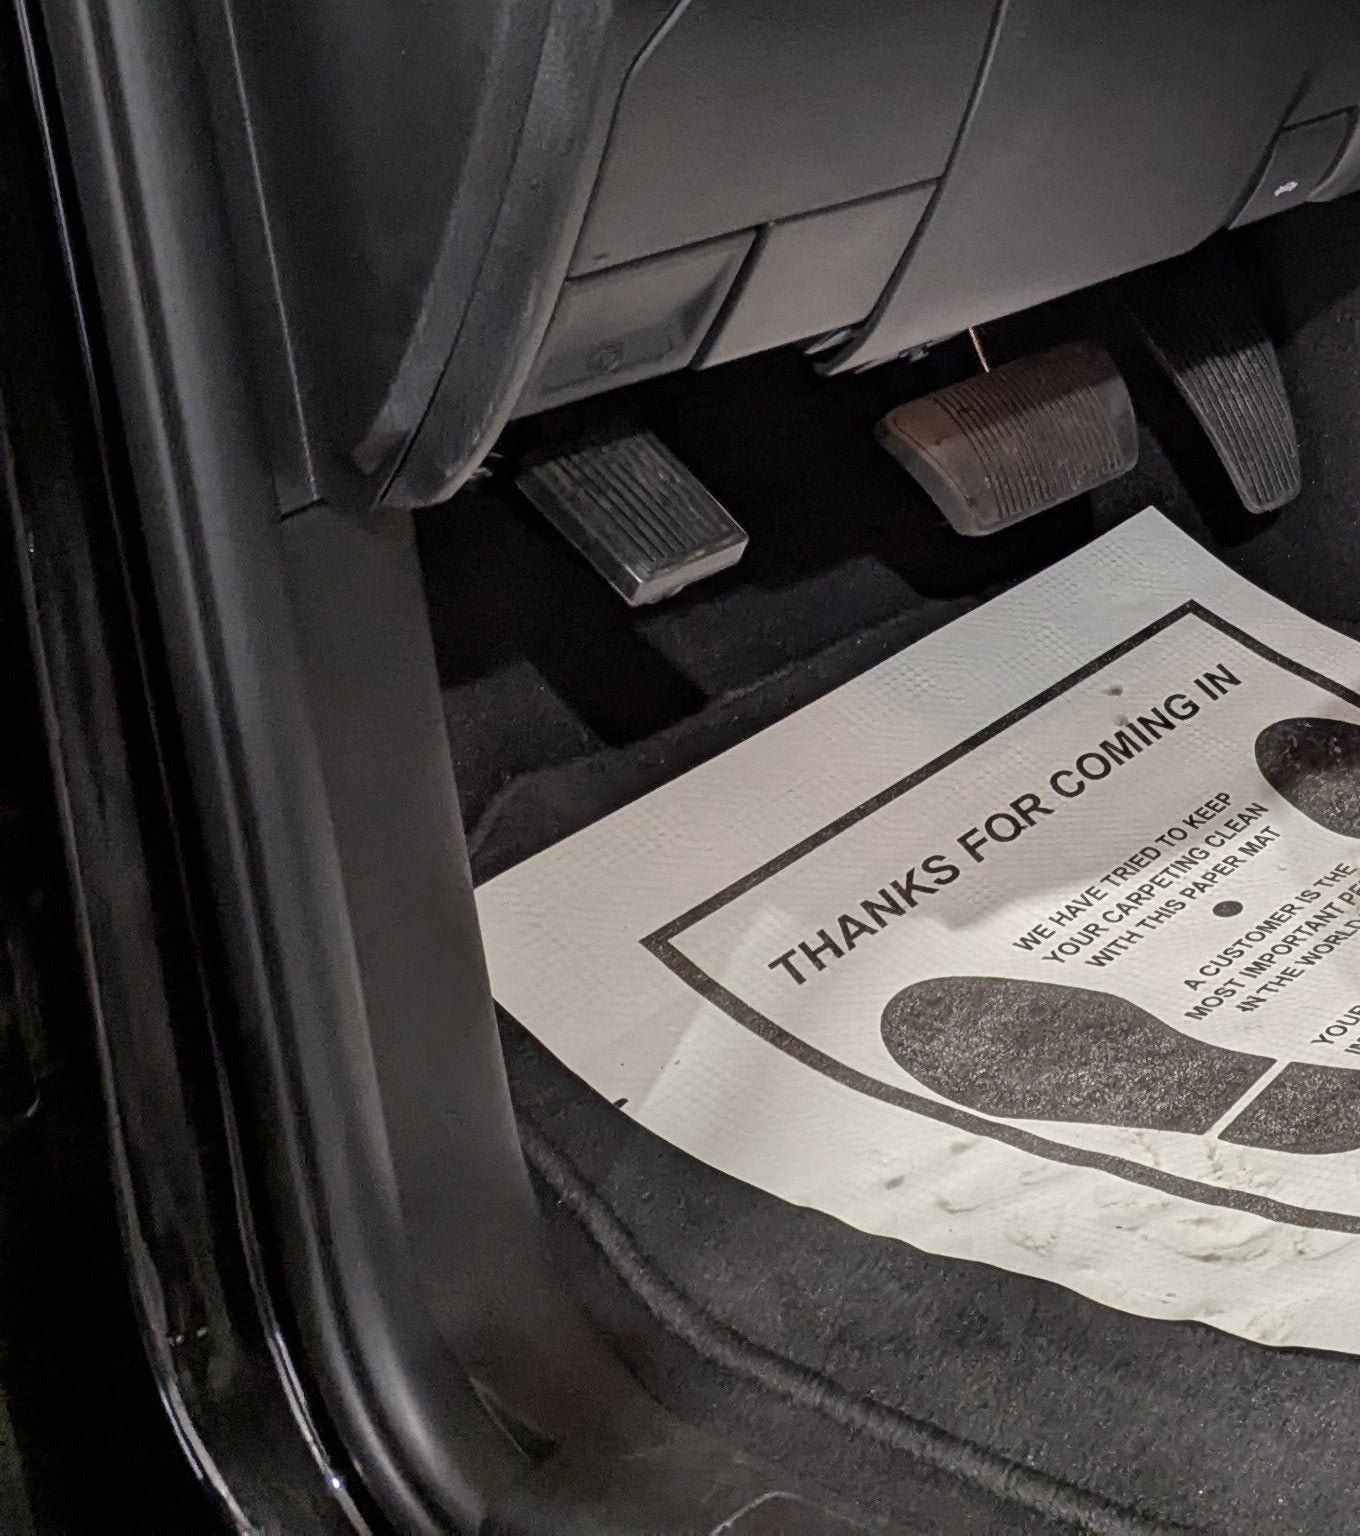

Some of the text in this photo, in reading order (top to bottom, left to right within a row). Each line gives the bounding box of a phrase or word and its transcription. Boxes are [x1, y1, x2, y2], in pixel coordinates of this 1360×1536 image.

[768, 663, 1243, 987] THANKS FOR COMING IN
[1012, 792, 1234, 952] WE HAVE TRIED TO KEEP
[1042, 802, 1270, 965] YOUR CARPETING CLEAN
[1084, 825, 1282, 968] WITH THIS PAPER MAT
[1184, 862, 1357, 991] A CUSTOMER IS THE
[1184, 977, 1246, 1020] MOST
[1239, 902, 1345, 979] IMPORTANT
[1236, 995, 1267, 1012] IN
[1256, 966, 1305, 993] THE
